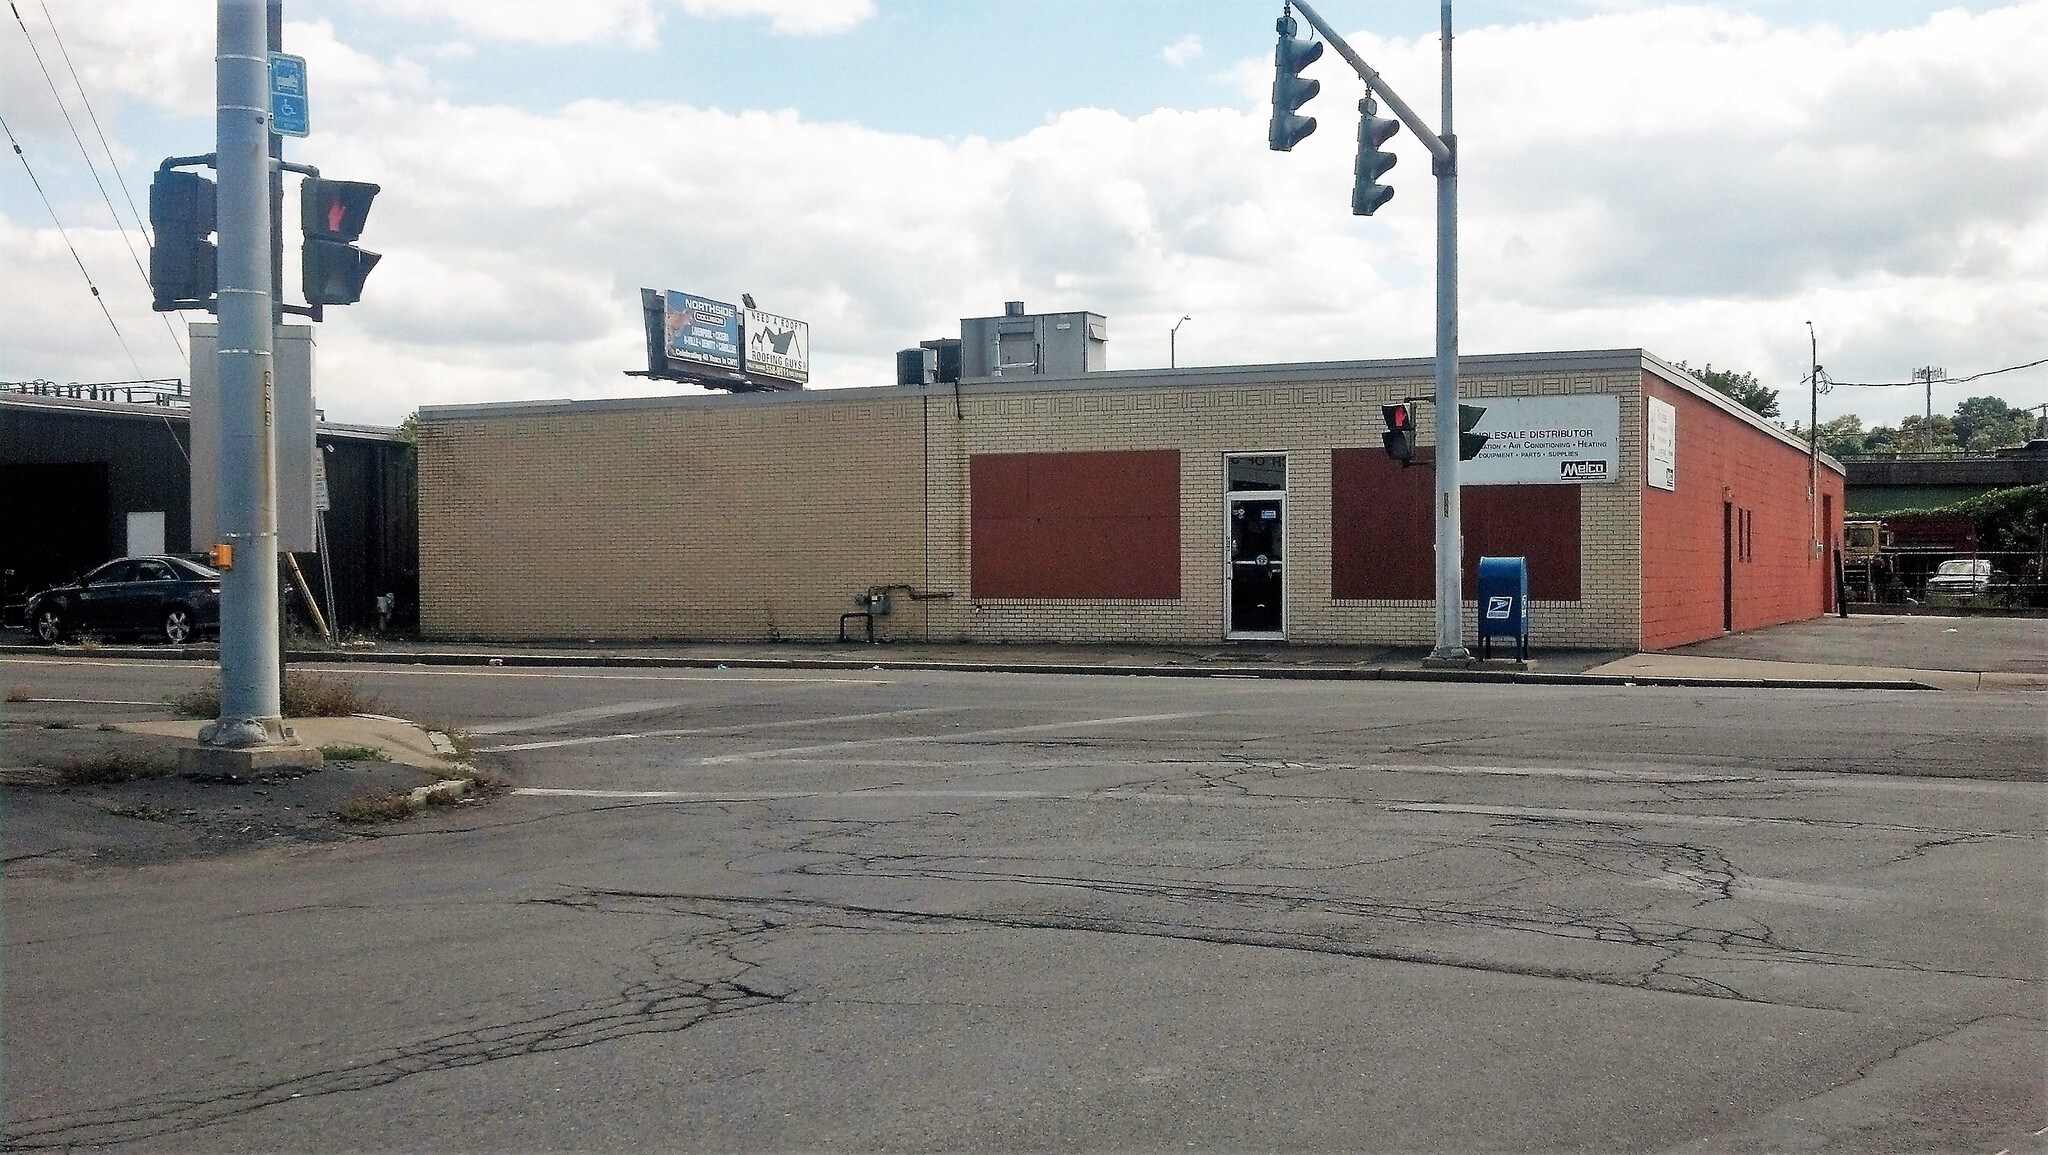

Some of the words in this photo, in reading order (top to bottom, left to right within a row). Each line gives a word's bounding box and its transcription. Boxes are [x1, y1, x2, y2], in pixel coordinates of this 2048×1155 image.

[685, 298, 734, 317] NORTHSIDE
[752, 311, 770, 324] NEED
[752, 350, 782, 366] ROOFING
[784, 357, 802, 370] GUYS
[1529, 429, 1594, 439] DISTRIBUTOR
[1548, 450, 1579, 458] SUPPLIES
[1562, 461, 1604, 476] Melco
